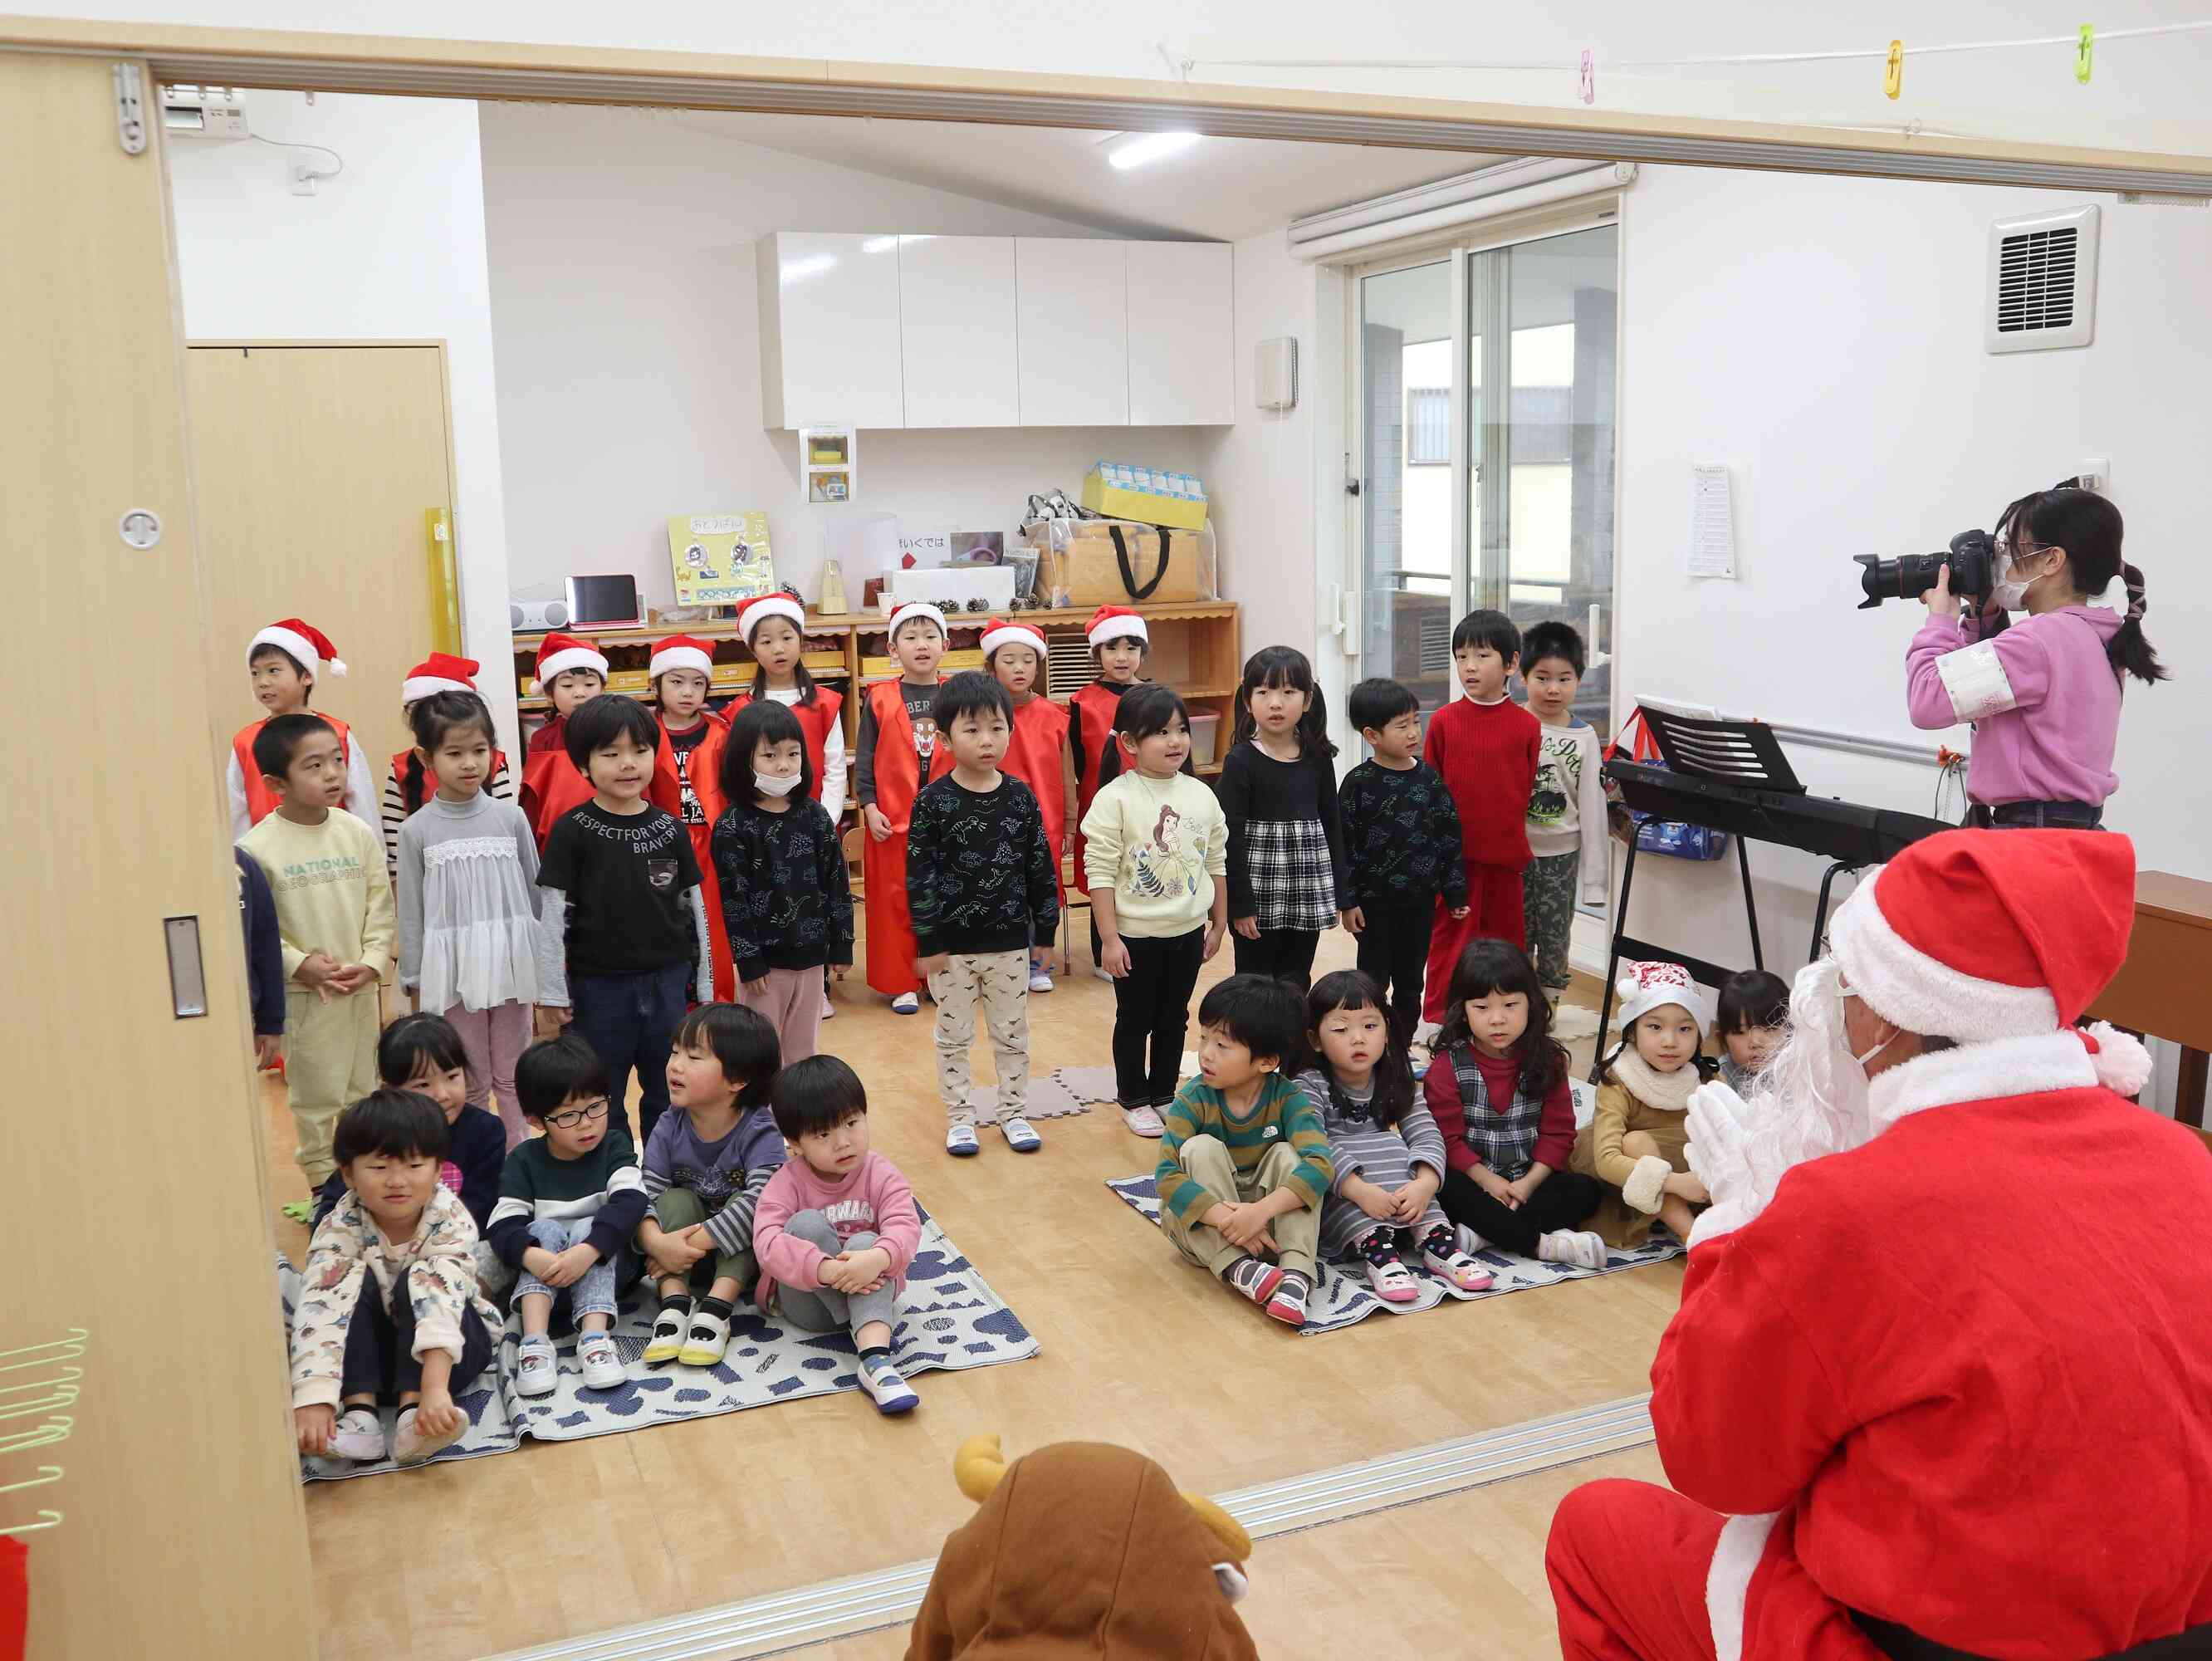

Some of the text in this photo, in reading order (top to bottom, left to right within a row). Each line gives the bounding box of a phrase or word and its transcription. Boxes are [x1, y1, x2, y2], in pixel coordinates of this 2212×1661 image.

[572, 811, 676, 841] RESPECT FOR YOUR
[633, 825, 678, 854] BRAVERY
[284, 856, 360, 878] NATIONAL
